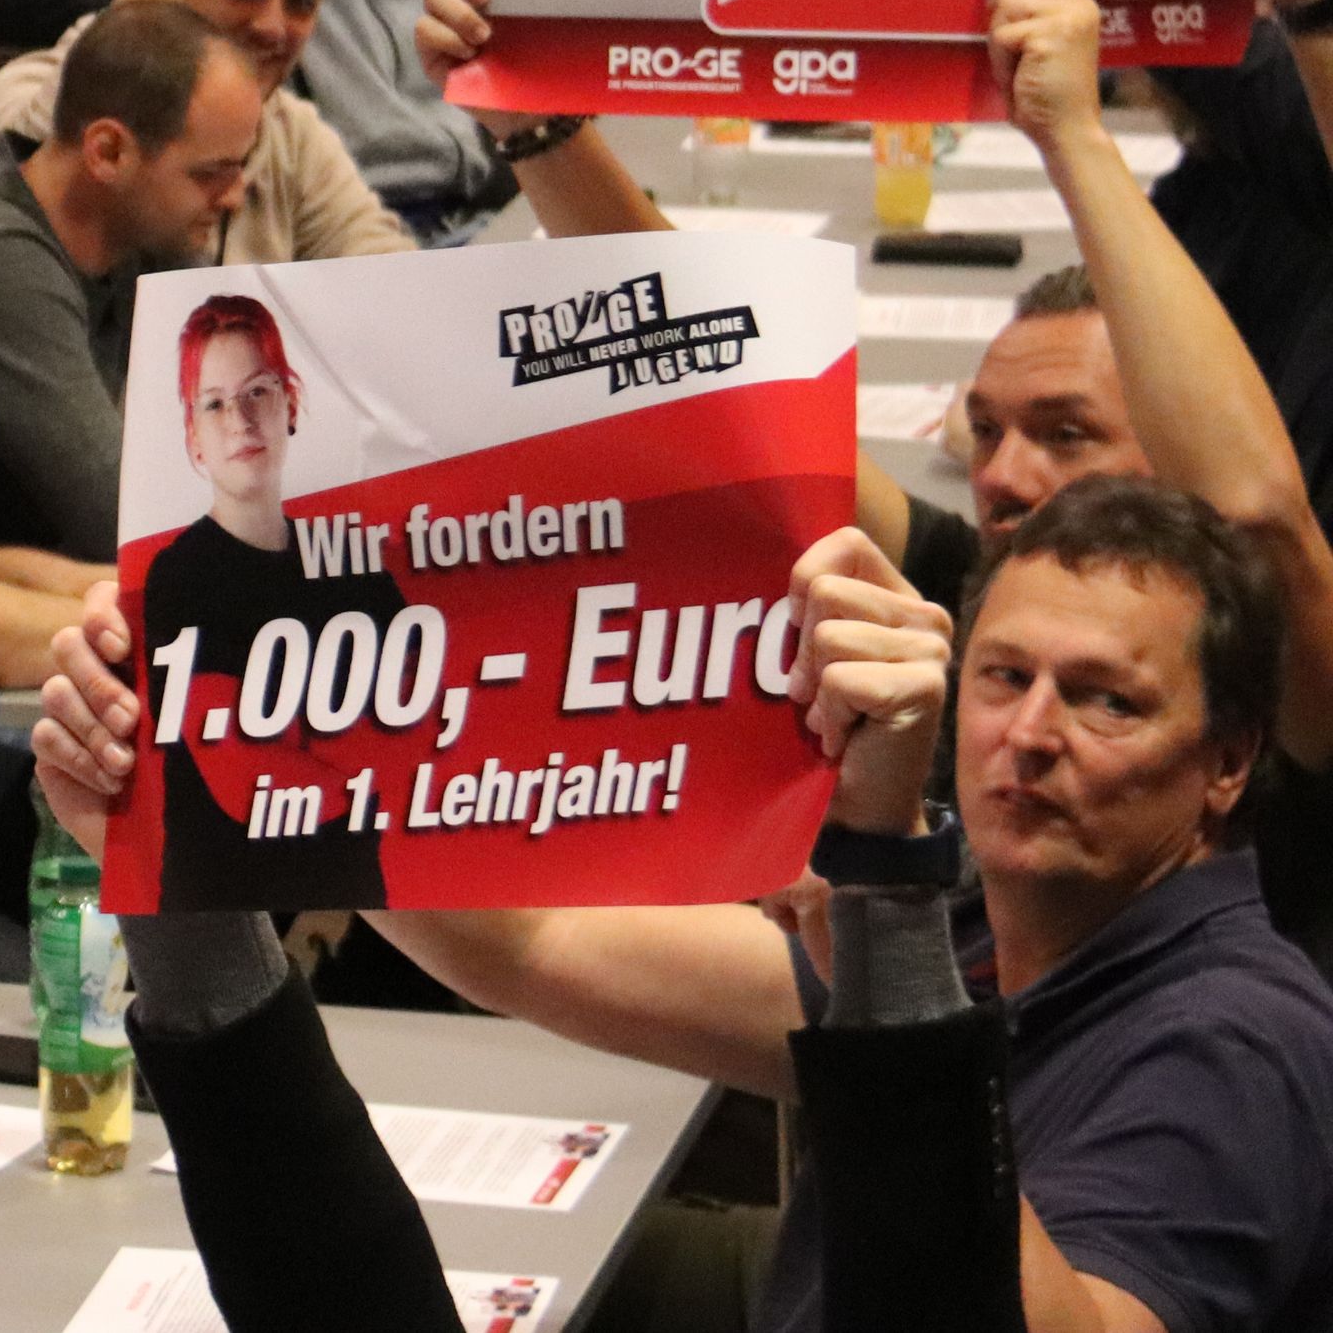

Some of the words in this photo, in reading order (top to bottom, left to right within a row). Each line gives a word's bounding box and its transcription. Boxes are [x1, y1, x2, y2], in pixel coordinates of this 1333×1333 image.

[1152, 3, 1206, 45] gpa
[608, 46, 742, 79] PRO-GE
[772, 49, 857, 95] gpa
[521, 360, 549, 378] YOU
[552, 354, 588, 371] WILL
[589, 338, 638, 362] NEVER
[640, 327, 685, 349] WORK
[689, 316, 745, 339] ALONE
[616, 340, 740, 386] JUGEND
[295, 515, 391, 580] Wir
[405, 494, 626, 571] fordern
[150, 602, 527, 750] 1.000,-
[247, 777, 322, 841] im
[345, 769, 390, 833] 1.
[406, 743, 688, 837] Lehrjahr!
